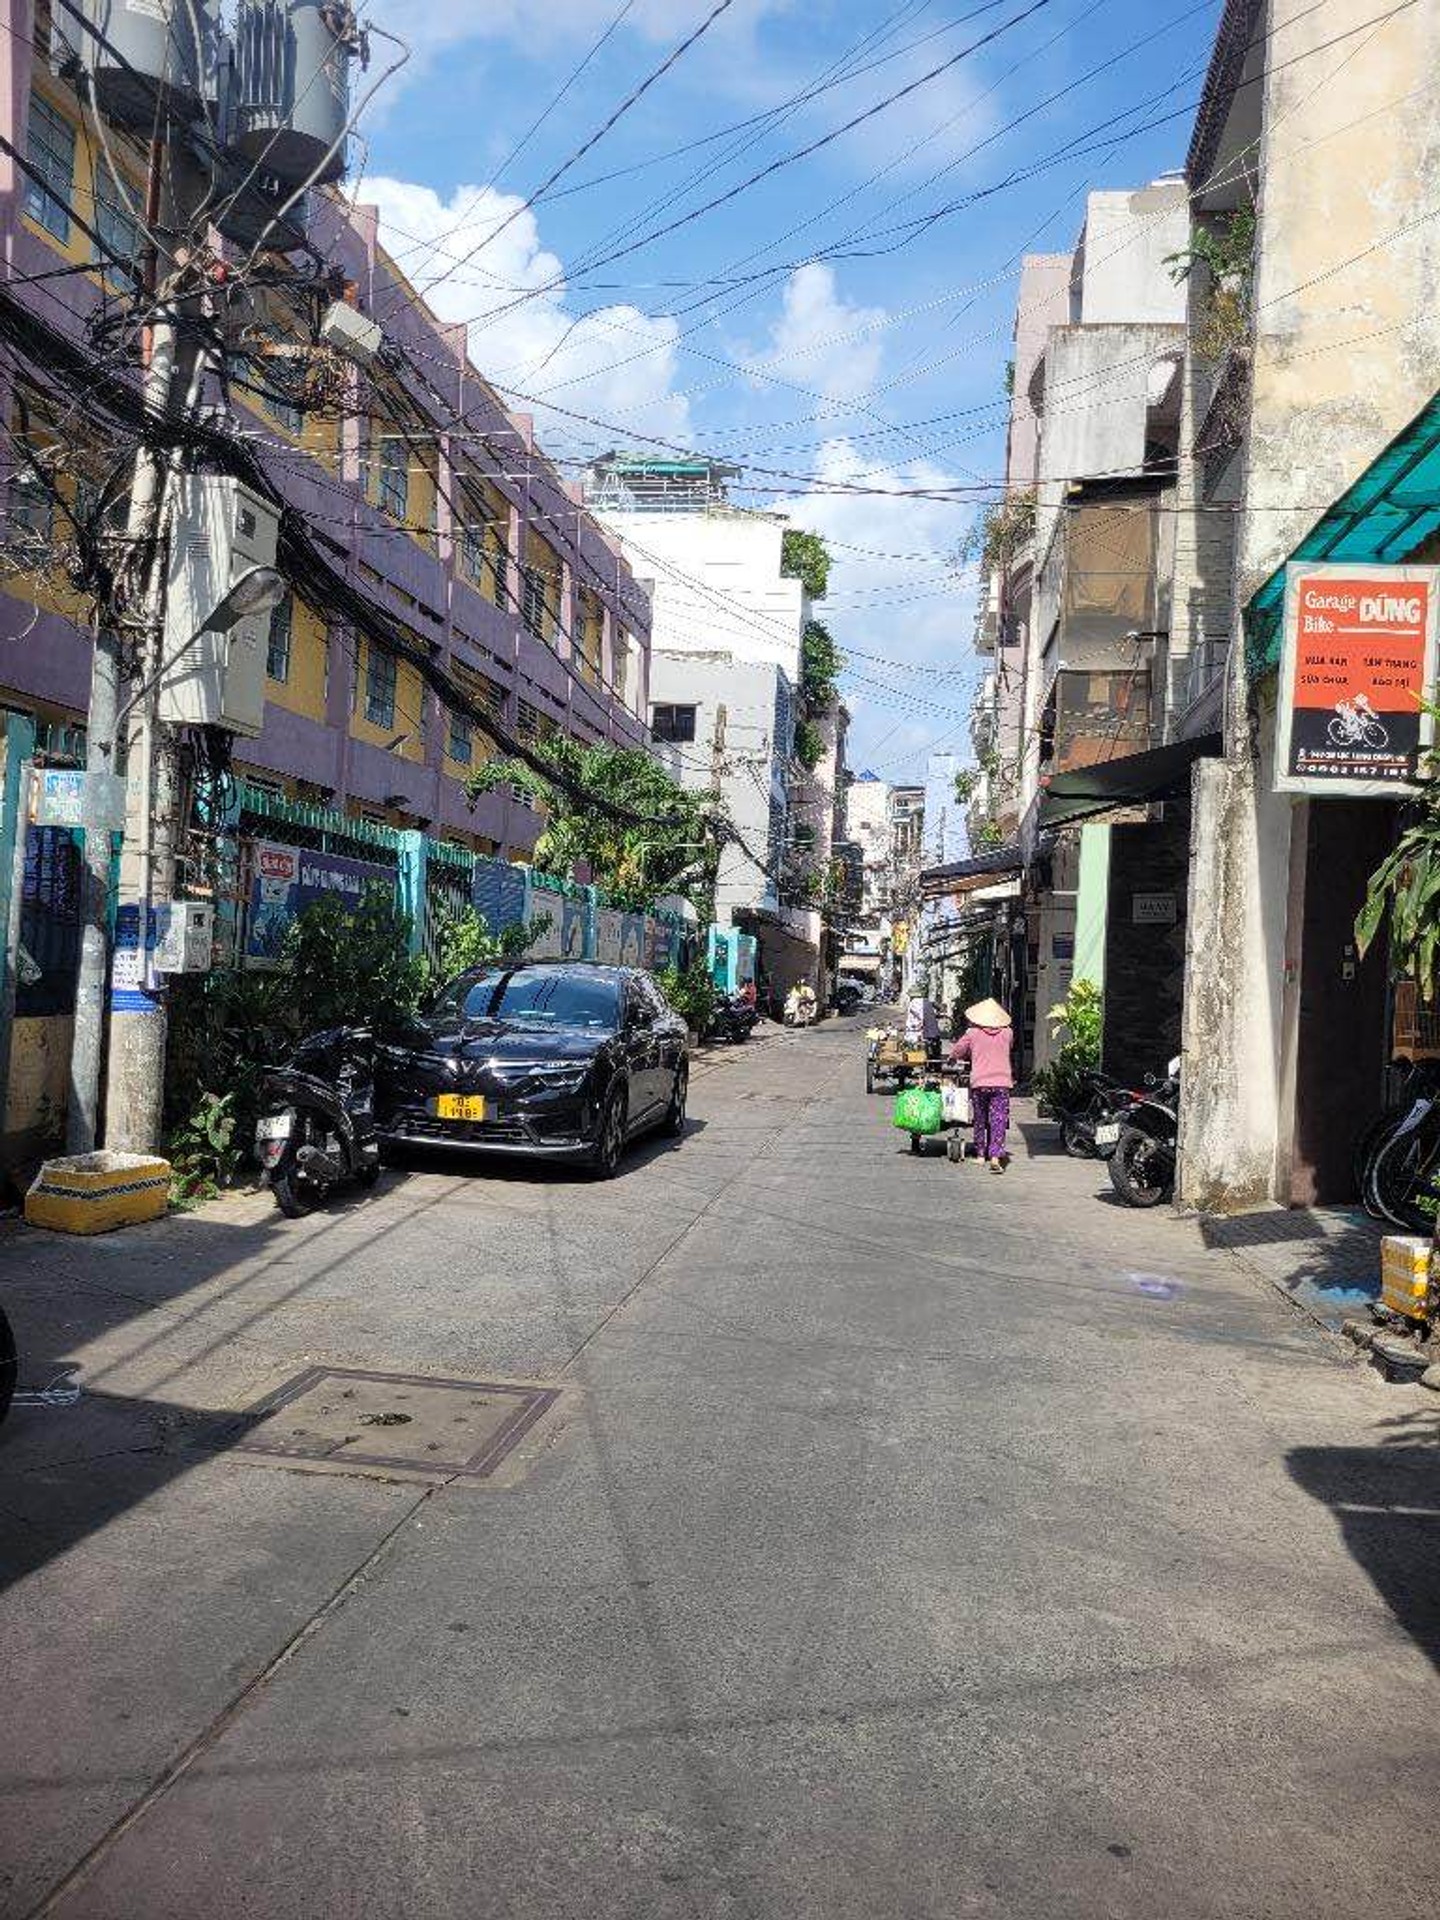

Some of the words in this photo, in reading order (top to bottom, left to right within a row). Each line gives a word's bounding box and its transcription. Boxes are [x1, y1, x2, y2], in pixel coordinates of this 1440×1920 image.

[1305, 591, 1356, 612] Garage
[1360, 594, 1421, 623] DŨNG
[1303, 614, 1334, 633] Bike
